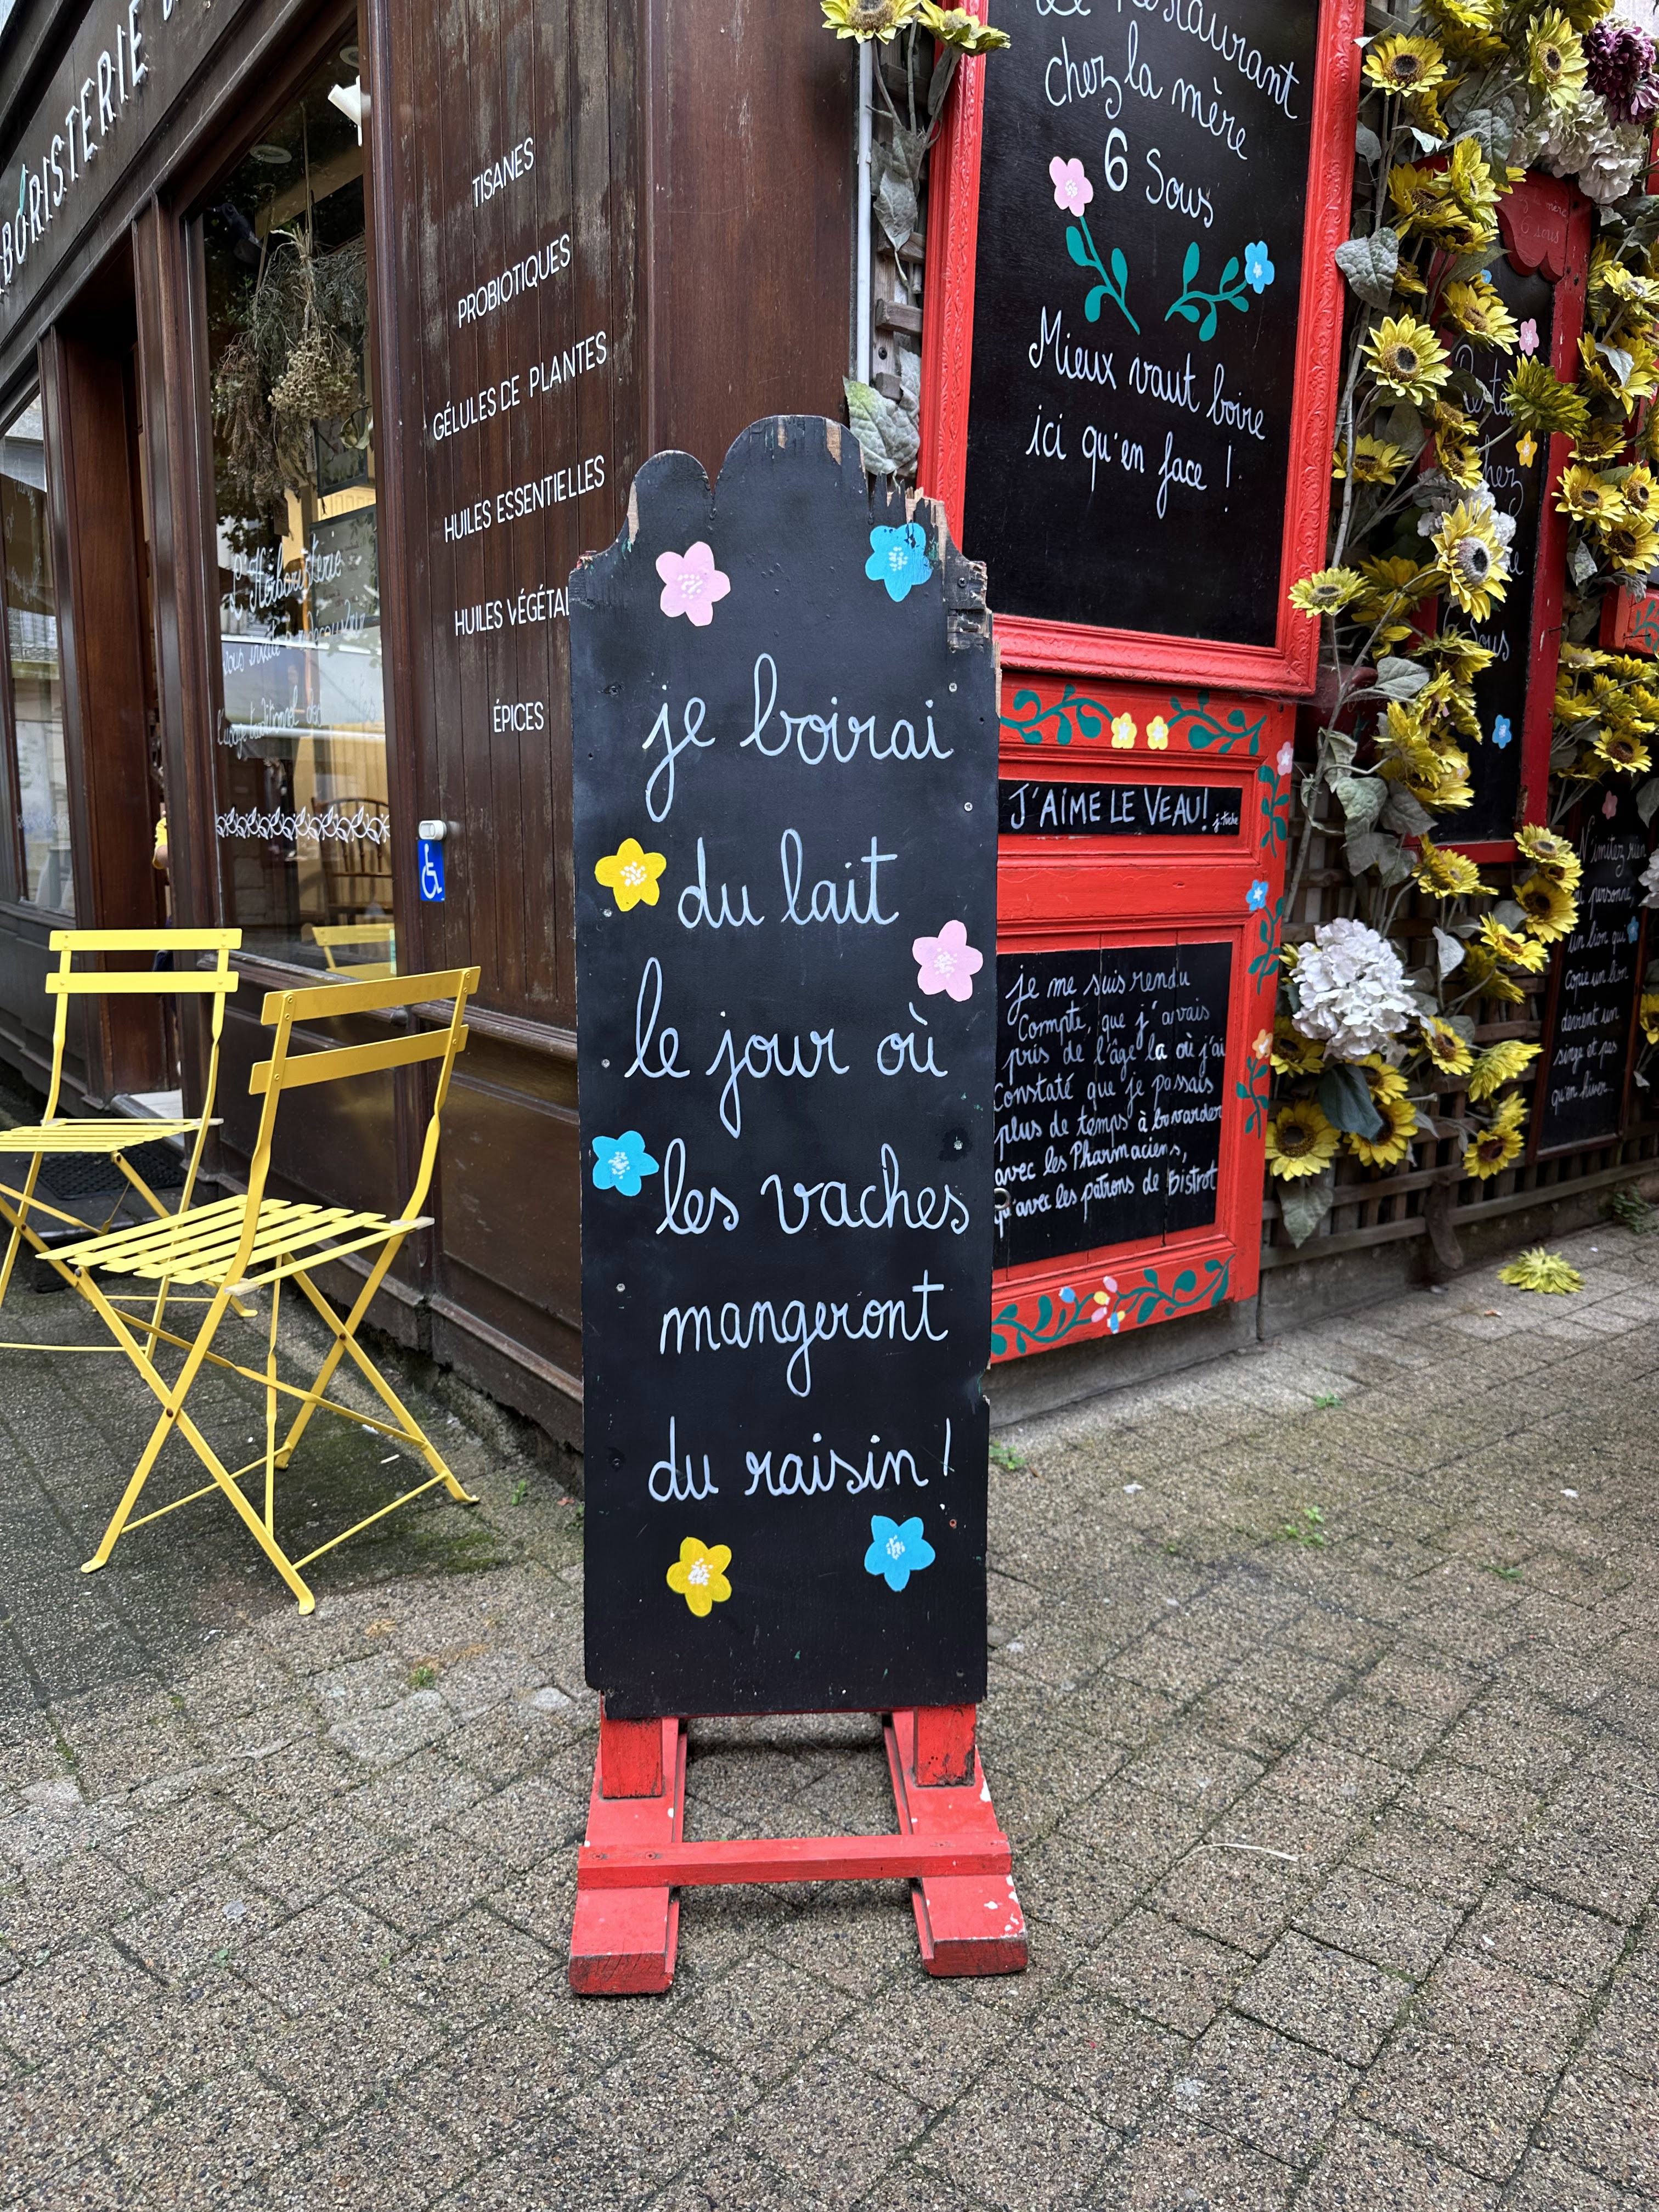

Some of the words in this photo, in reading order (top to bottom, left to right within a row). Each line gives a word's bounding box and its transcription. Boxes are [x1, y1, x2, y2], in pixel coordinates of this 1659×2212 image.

[1046, 37, 1122, 120] chez
[1125, 20, 1163, 100] la
[1171, 77, 1247, 160] mère
[0, 0, 146, 292] BORISTERIE
[472, 137, 534, 207] TISANES
[1104, 127, 1128, 191] 6
[1146, 148, 1214, 228] Sous
[458, 234, 571, 328] PROBIOTIQUES
[433, 387, 496, 441] GÉLULES
[500, 375, 521, 412] DE
[529, 331, 607, 397] PLANTES
[1029, 306, 1116, 389] Mieux
[1129, 353, 1200, 413] vaut
[1207, 363, 1265, 440] boire
[1026, 404, 1066, 460] ici
[1081, 426, 1144, 492] qu'en
[1156, 431, 1207, 519] face
[1224, 441, 1232, 512] !
[1476, 434, 1524, 517] hez
[444, 499, 491, 543] HUILES
[497, 455, 605, 524] ESSENTIELLES
[455, 600, 503, 636] HUILES
[507, 584, 569, 626] VÉGÉTAL
[494, 699, 544, 733] ÉPICES
[642, 684, 716, 823] je
[740, 653, 954, 765] boirai
[1110, 789, 1135, 823] LE
[1144, 787, 1208, 832] VEAU!
[678, 837, 765, 928] du
[781, 828, 900, 926] lait
[1627, 835, 1647, 861] rien
[1567, 934, 1585, 953] un
[1586, 920, 1608, 948] lion
[1612, 924, 1626, 955] qui
[1005, 964, 1040, 1026] je
[1047, 976, 1077, 998] me
[1083, 969, 1126, 996] suis
[1129, 967, 1190, 992] rendu
[1591, 969, 1606, 986] un
[1607, 960, 1629, 983] lion
[624, 957, 690, 1078] le
[706, 1010, 850, 1138] jour
[877, 1002, 949, 1077] où
[1102, 1013, 1126, 1042] que
[1600, 1007, 1620, 1024] un
[1001, 1043, 1050, 1085] pris
[1063, 1040, 1085, 1065] de
[1093, 1035, 1137, 1082] l'âge
[1145, 1033, 1168, 1062] la
[1176, 1032, 1195, 1059] où
[1198, 1035, 1226, 1079] j'ai
[1586, 1036, 1598, 1058] et
[1599, 1040, 1618, 1070] pas
[1087, 1081, 1116, 1111] que
[1125, 1071, 1145, 1120] je
[1151, 1075, 1215, 1111] passais
[994, 1116, 1042, 1162] plus
[1049, 1110, 1069, 1138] de
[1076, 1105, 1128, 1148] temps
[1138, 1110, 1149, 1133] à
[995, 1161, 1037, 1186] avec
[1043, 1145, 1068, 1176] les
[656, 1138, 740, 1234] les
[760, 1143, 970, 1234] vaches
[1056, 1183, 1077, 1209] les
[1080, 1173, 1135, 1223] patrons
[1143, 1167, 1159, 1195] de
[659, 1269, 949, 1397] mangeront
[648, 1416, 719, 1502] du
[744, 1432, 928, 1497] raisin
[939, 1418, 952, 1510] !
